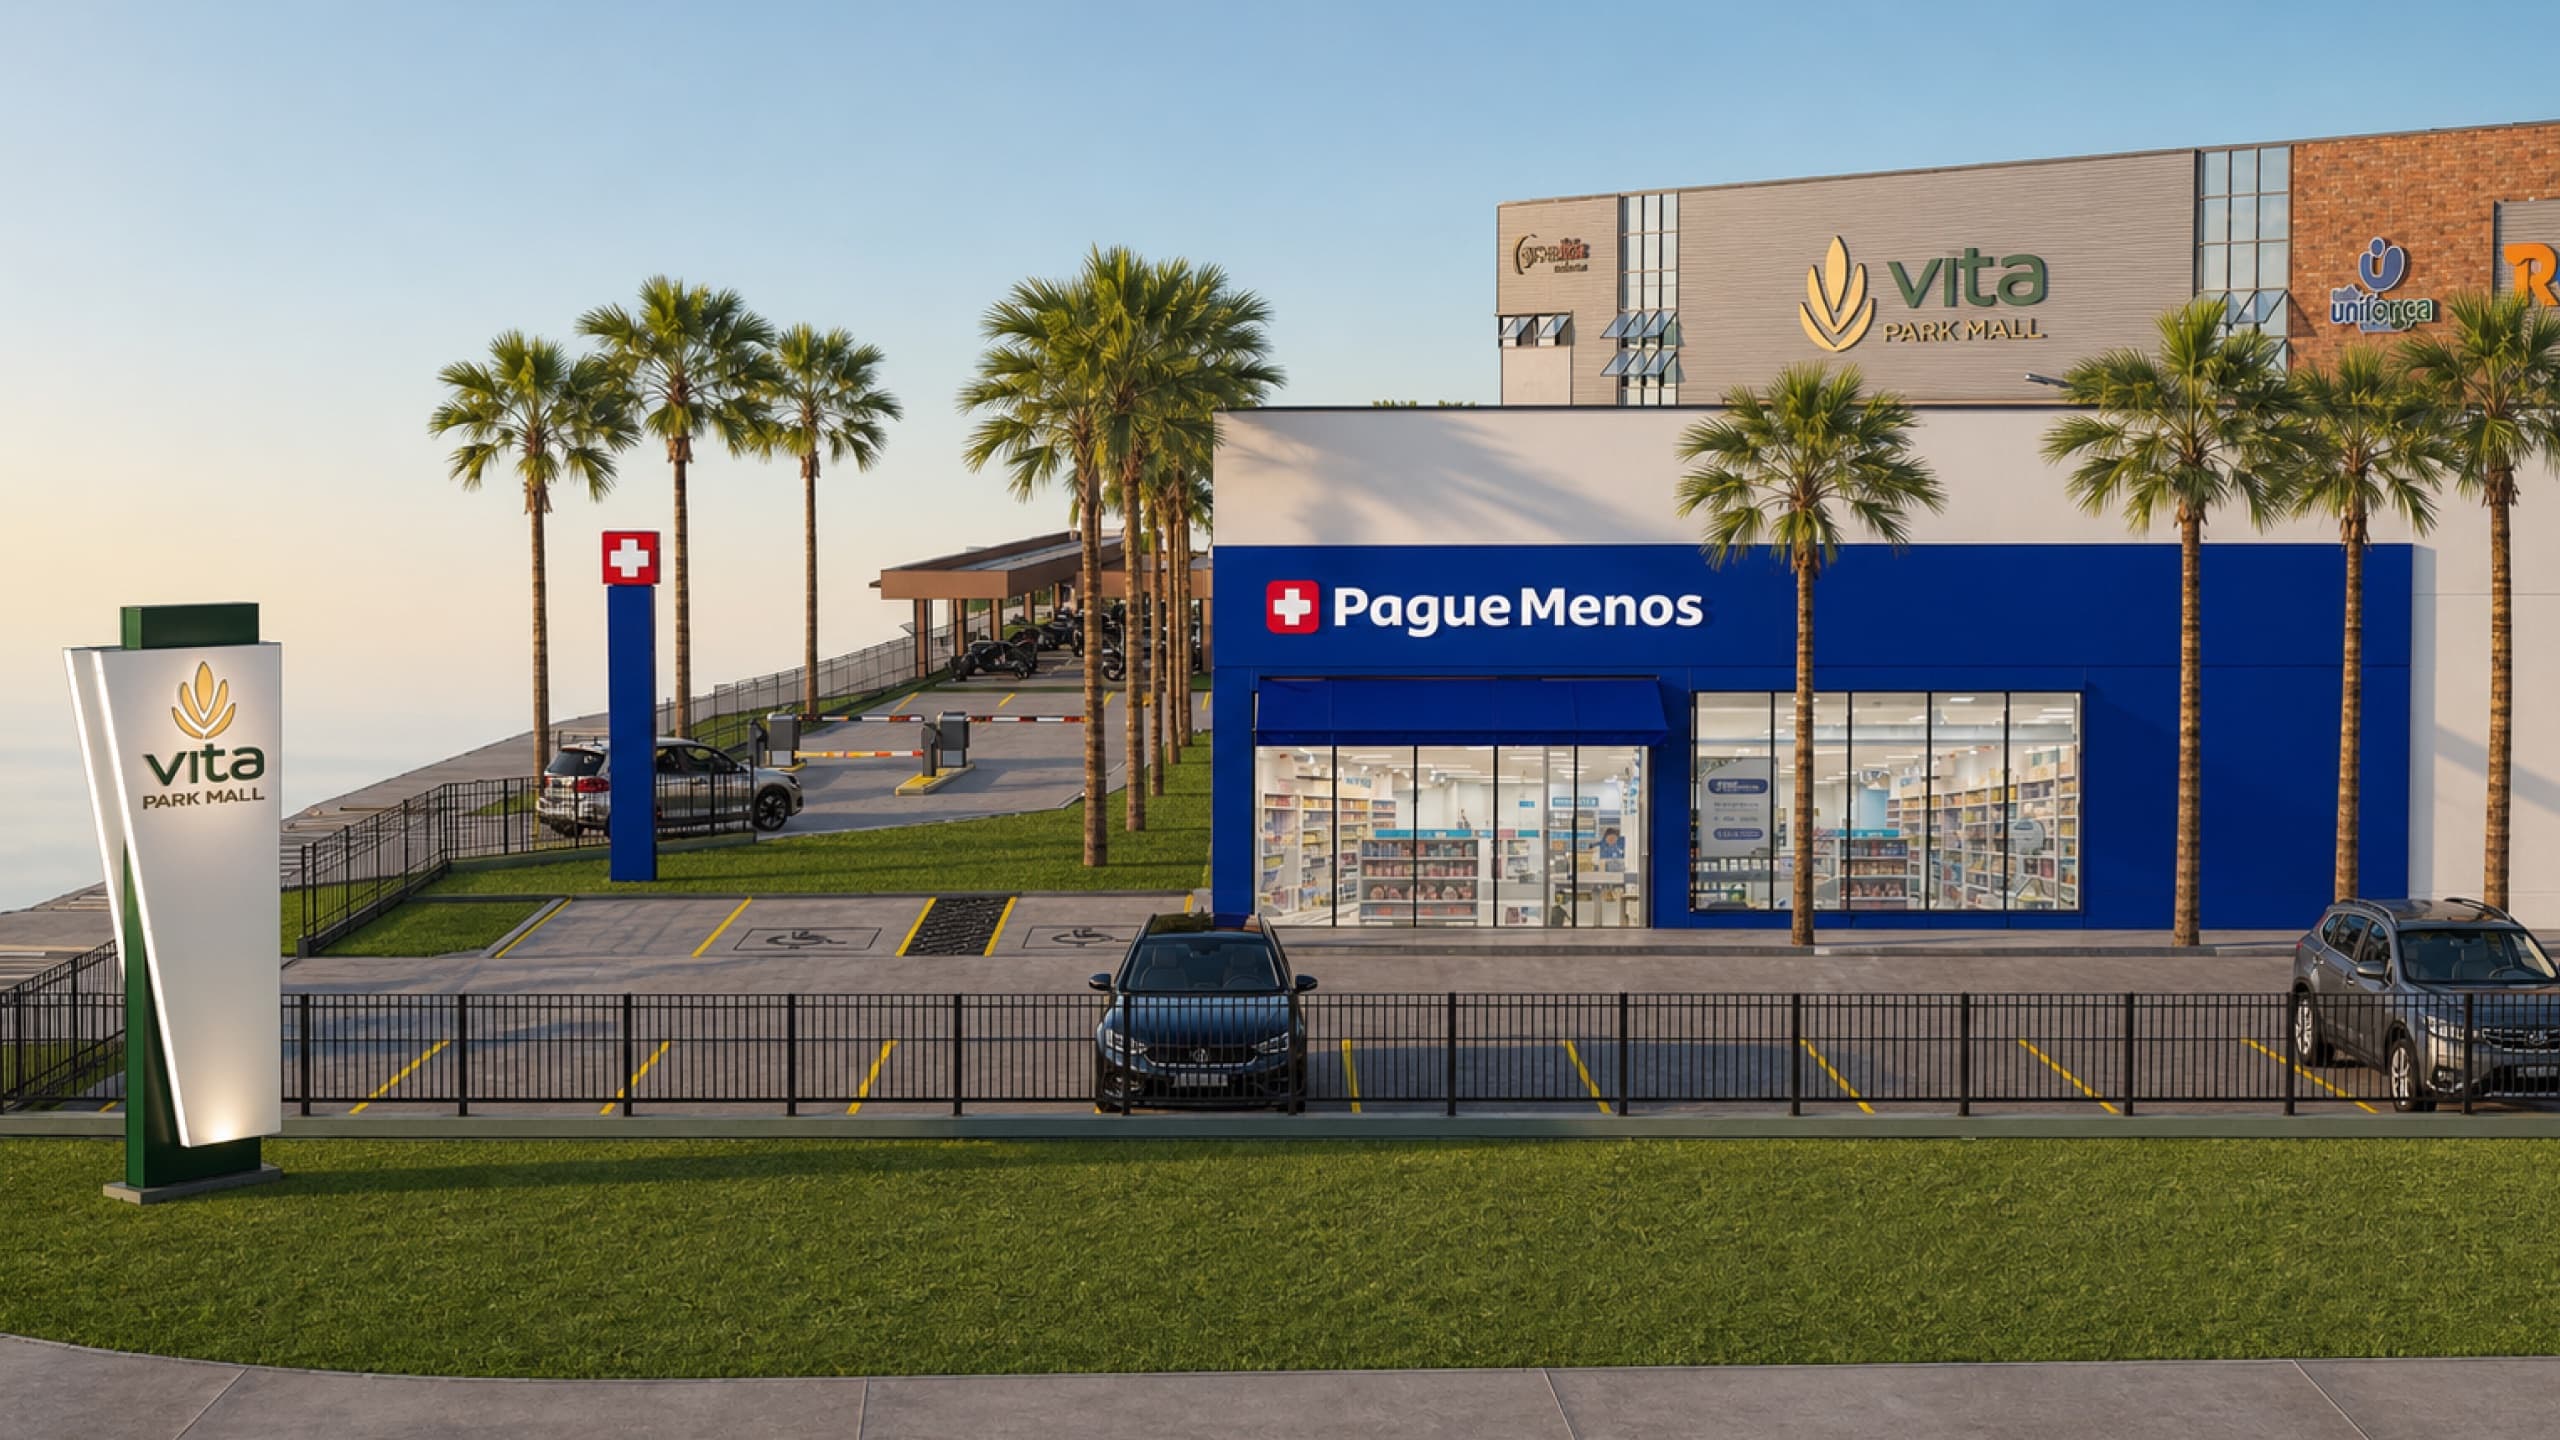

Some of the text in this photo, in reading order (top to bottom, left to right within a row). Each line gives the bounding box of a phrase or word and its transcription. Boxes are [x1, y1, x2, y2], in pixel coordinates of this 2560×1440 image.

[1887, 247, 2048, 308] vita
[2503, 242, 2560, 306] R
[1884, 318, 2048, 343] PARK MALL
[1333, 586, 1704, 638] Pague Menos
[143, 743, 265, 786] vita
[142, 787, 265, 810] PARK MALL
